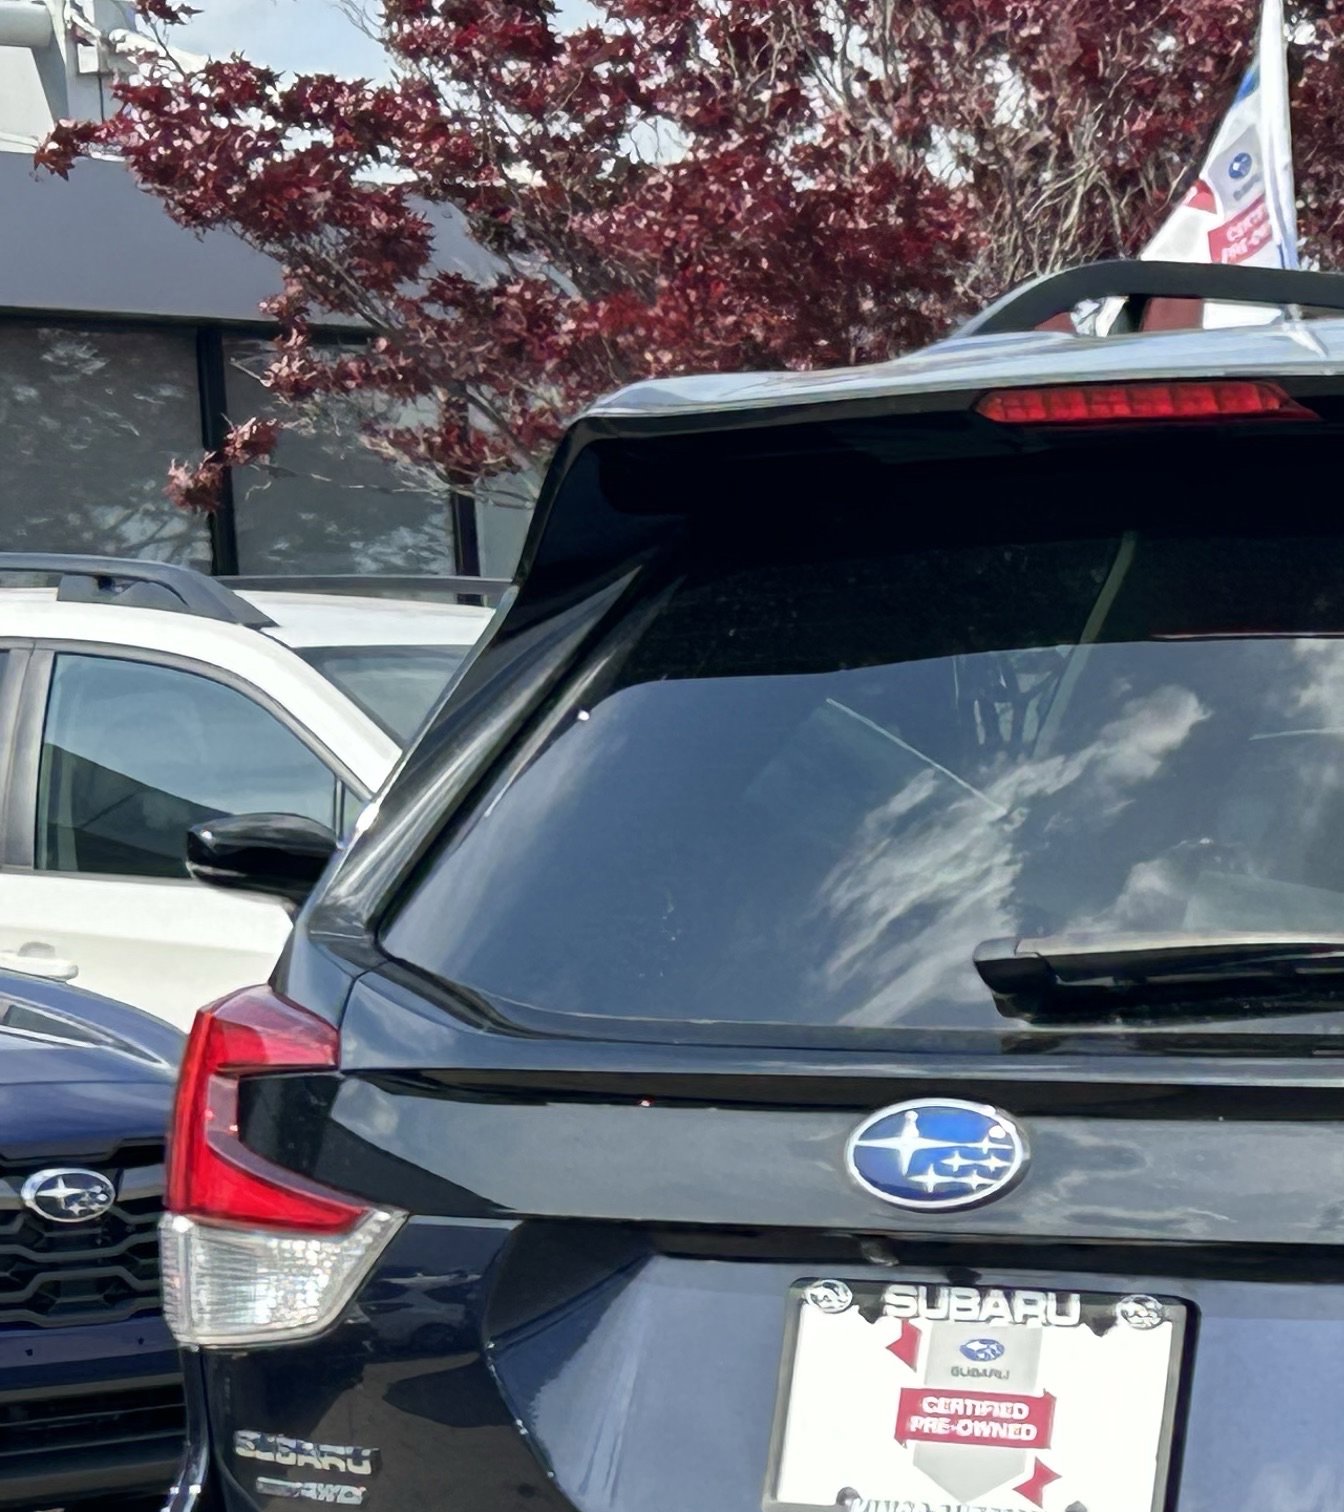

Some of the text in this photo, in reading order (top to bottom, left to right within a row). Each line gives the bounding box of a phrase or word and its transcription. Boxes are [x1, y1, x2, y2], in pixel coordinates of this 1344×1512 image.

[883, 1284, 1081, 1327] SUBARU
[921, 1396, 1030, 1420] CERTIFIED
[909, 1416, 1038, 1441] PRE-OWNED
[235, 1429, 375, 1475] SUBARU
